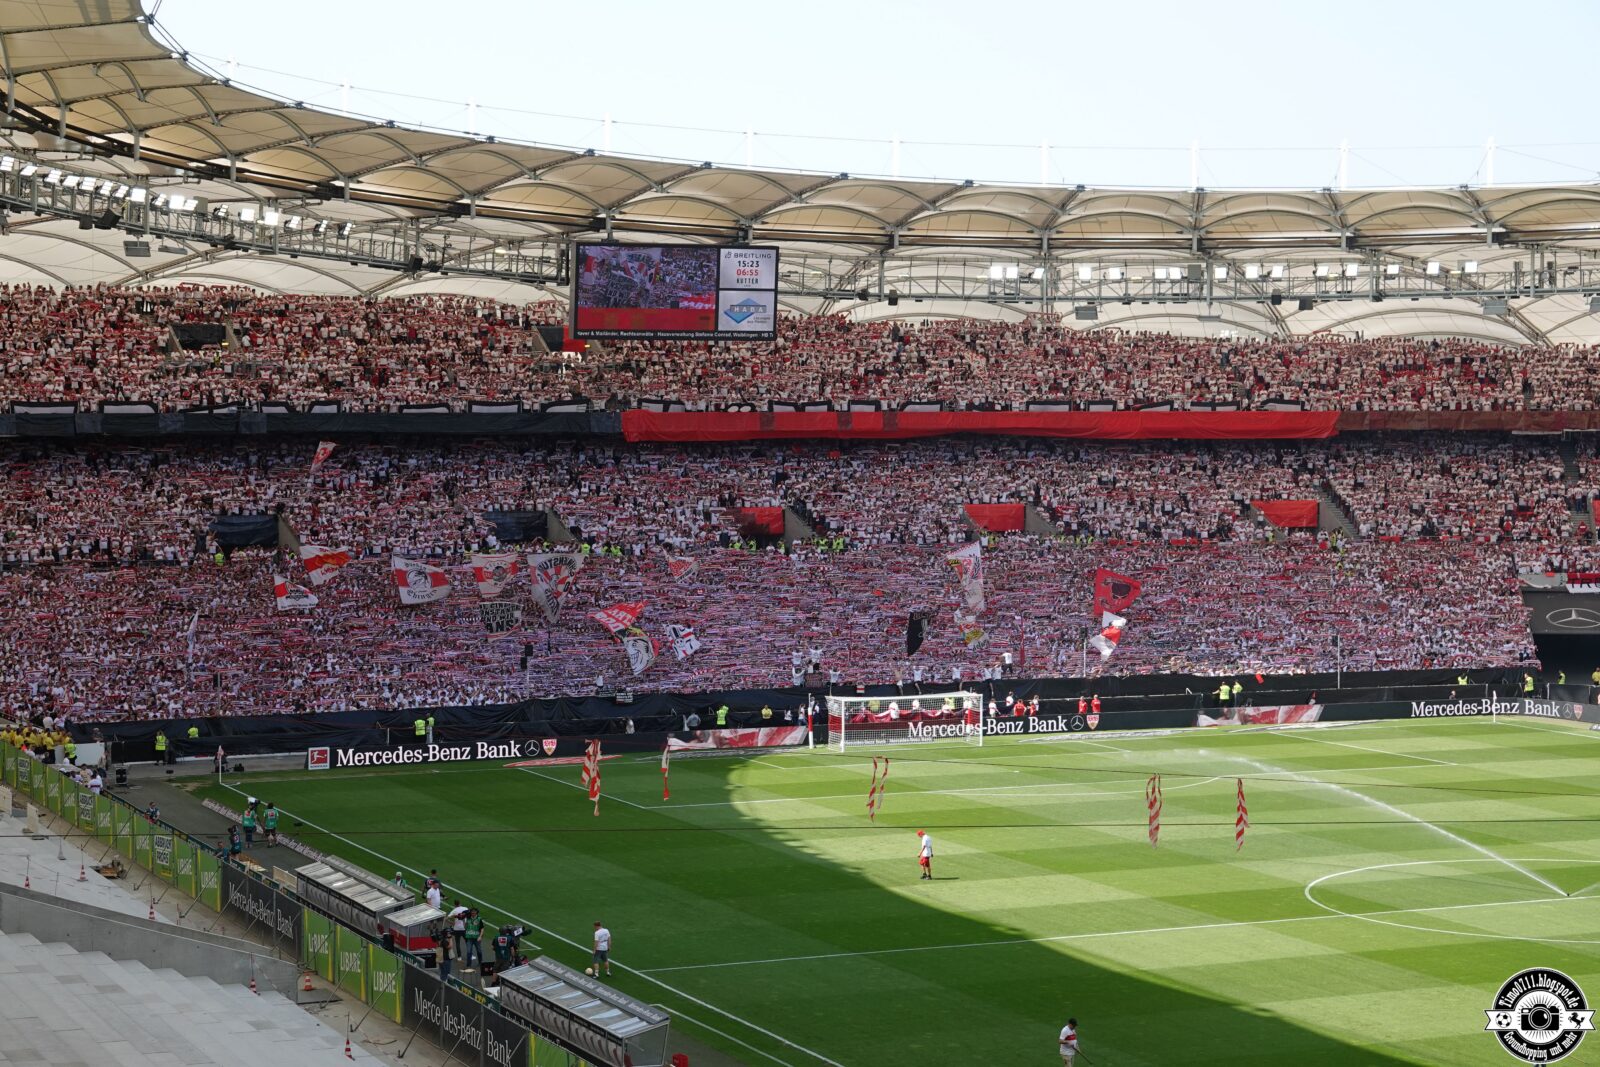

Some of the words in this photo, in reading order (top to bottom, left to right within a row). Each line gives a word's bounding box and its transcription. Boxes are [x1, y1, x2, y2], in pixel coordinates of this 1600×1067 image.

[736, 268, 759, 276] 06:55
[737, 260, 760, 268] 15:23
[1411, 699, 1520, 718] Mercedes-Benz
[1524, 701, 1560, 717] Bank
[907, 718, 1024, 738] Mercedes-Benz
[1028, 716, 1068, 733] Bank
[336, 744, 471, 767] Mercedes-Benz
[476, 740, 522, 759] Bank
[229, 881, 275, 927] Mercedes-Benz
[277, 908, 294, 939] Bank
[373, 970, 396, 994] LIBARE
[486, 1028, 512, 1067] Bank
